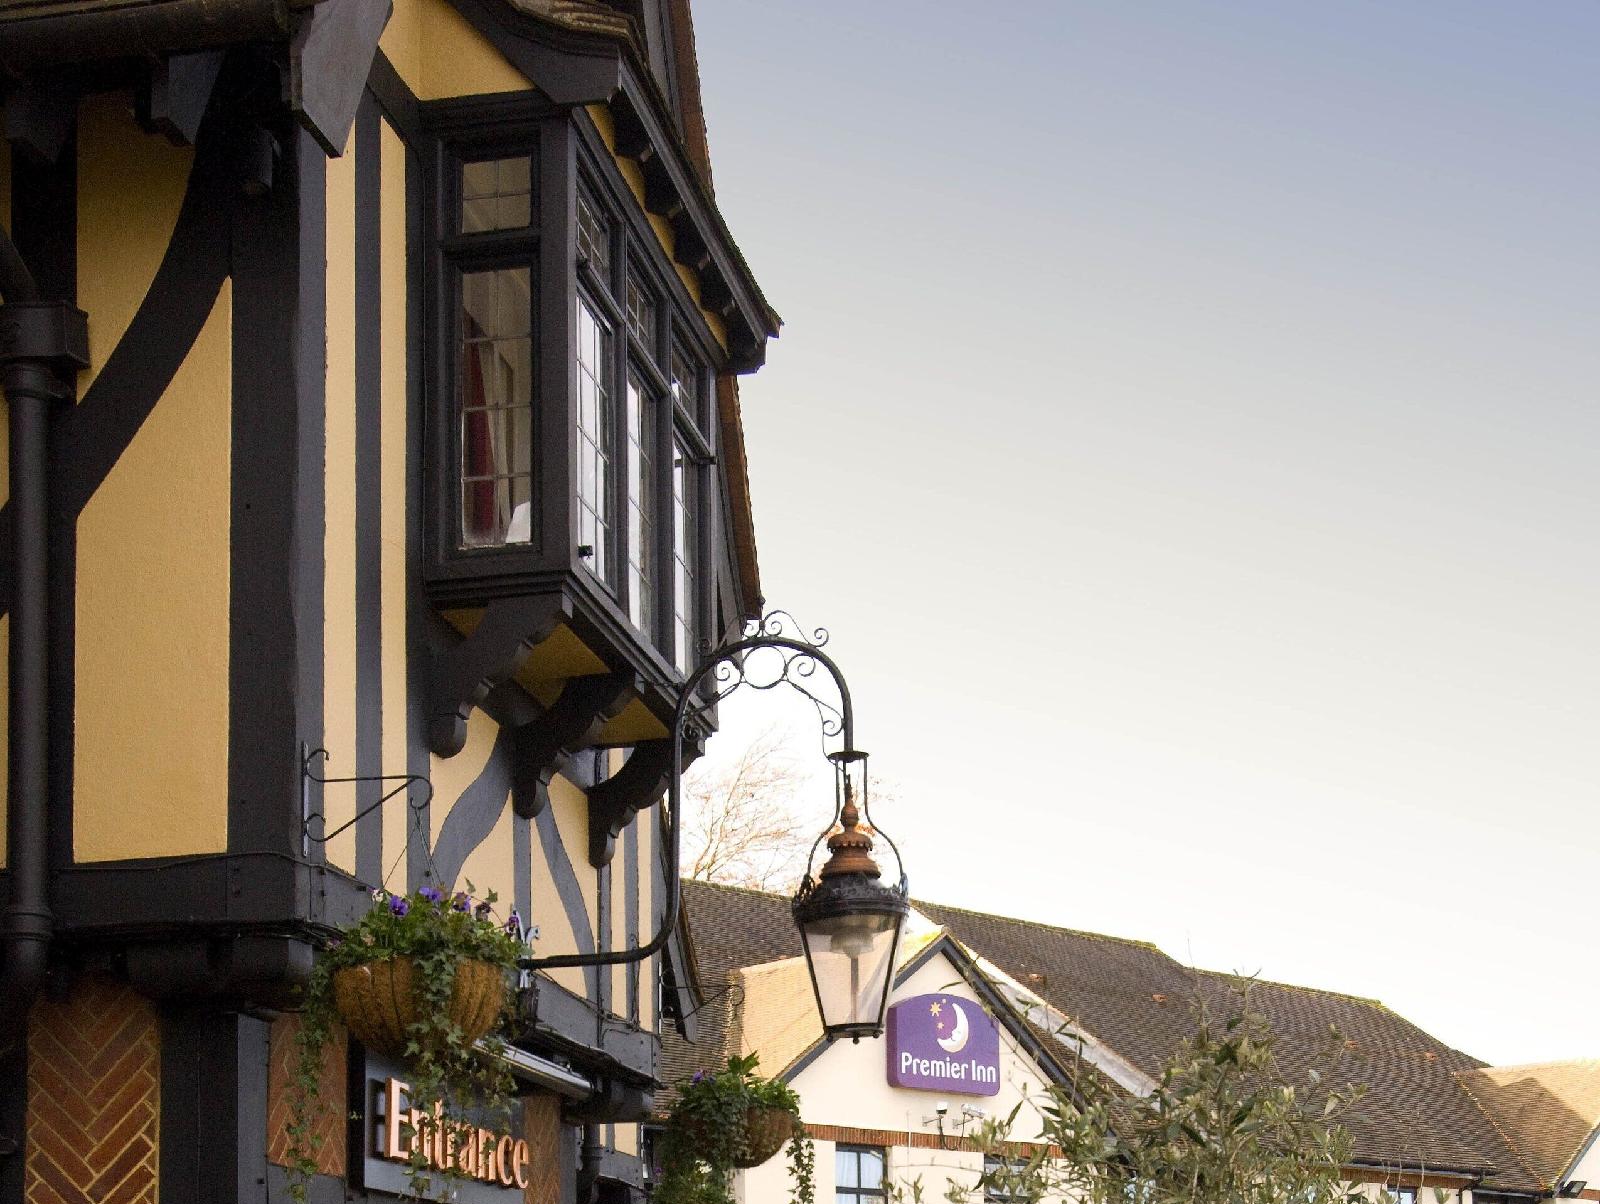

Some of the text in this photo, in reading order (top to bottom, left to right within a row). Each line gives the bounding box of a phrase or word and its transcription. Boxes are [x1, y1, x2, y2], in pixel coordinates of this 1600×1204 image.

[901, 1052, 996, 1082] Premier Inn
[385, 1077, 529, 1189] Entrance
